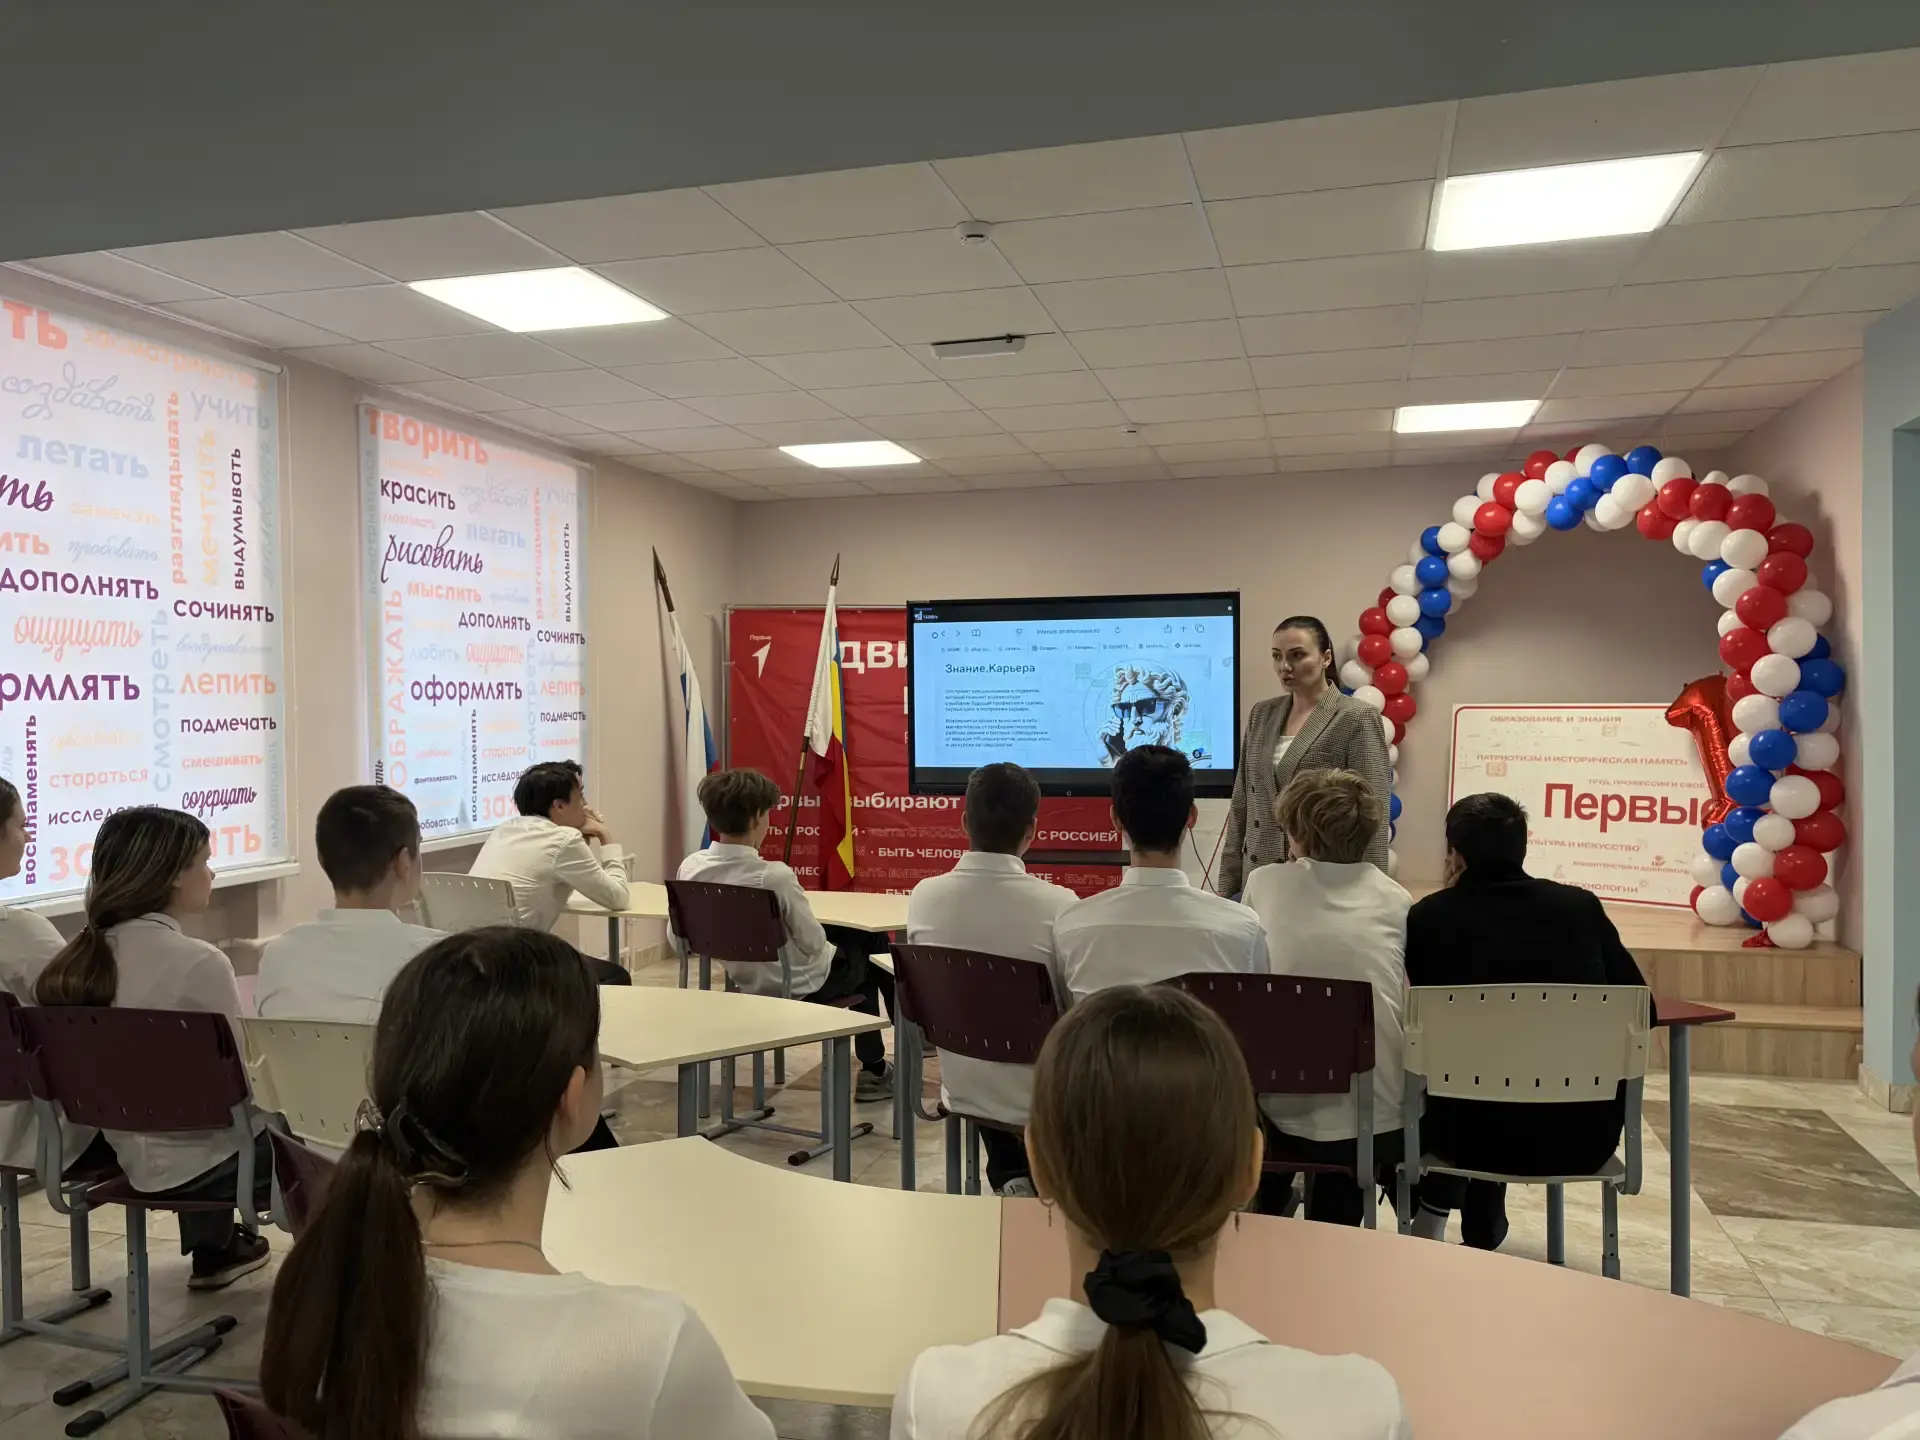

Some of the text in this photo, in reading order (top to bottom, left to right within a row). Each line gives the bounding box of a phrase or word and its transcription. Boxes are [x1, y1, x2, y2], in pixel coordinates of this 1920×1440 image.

[3, 300, 68, 350] ть
[1, 361, 156, 422] создавать
[366, 407, 489, 466] творить
[15, 434, 149, 479] летать
[167, 391, 188, 585] разглядывать
[380, 478, 456, 511] красить
[230, 448, 247, 590] выдумывать
[0, 531, 51, 556] ить
[465, 522, 526, 549] летать
[380, 525, 484, 584] рисовать
[0, 567, 160, 601] дополнять
[407, 581, 482, 604] мыслить
[173, 599, 274, 624] сочинять
[458, 612, 531, 632] дополнять
[13, 614, 143, 663] ощущать
[536, 629, 586, 645] сочинять
[839, 640, 909, 674] ДВ
[944, 663, 1036, 675] Знание.Карьера
[0, 672, 141, 712] рмлять
[180, 671, 277, 695] лепить
[386, 590, 408, 789] ОБРАЖАТЬ
[411, 673, 524, 707] оформлять
[540, 680, 586, 697] лепить
[151, 608, 175, 793] смотреть
[180, 716, 277, 734] подмечать
[540, 711, 588, 723] подмечать
[1489, 715, 1622, 723] ОБРАЗОВАНИЕ И ЗНАНИЯ
[481, 746, 527, 760] стараться
[1476, 753, 1542, 762] ПАТРИОТИЗМ
[1553, 756, 1638, 766] ИСТОРИЧЕСКАЯ
[1640, 758, 1688, 767] ПАМЯТЬ
[49, 768, 148, 790] стараться
[481, 768, 526, 784] исследова
[25, 714, 37, 885] воспламенять
[182, 785, 257, 818] созерцать
[849, 791, 960, 812] ыбирают
[1544, 782, 1700, 833] Первы
[1037, 831, 1118, 843] С РОССИЕЙ
[1577, 842, 1640, 852] ИСКУССТВО
[878, 847, 915, 858] БЫТЬ
[916, 848, 970, 859] ЧЕЛОВ
